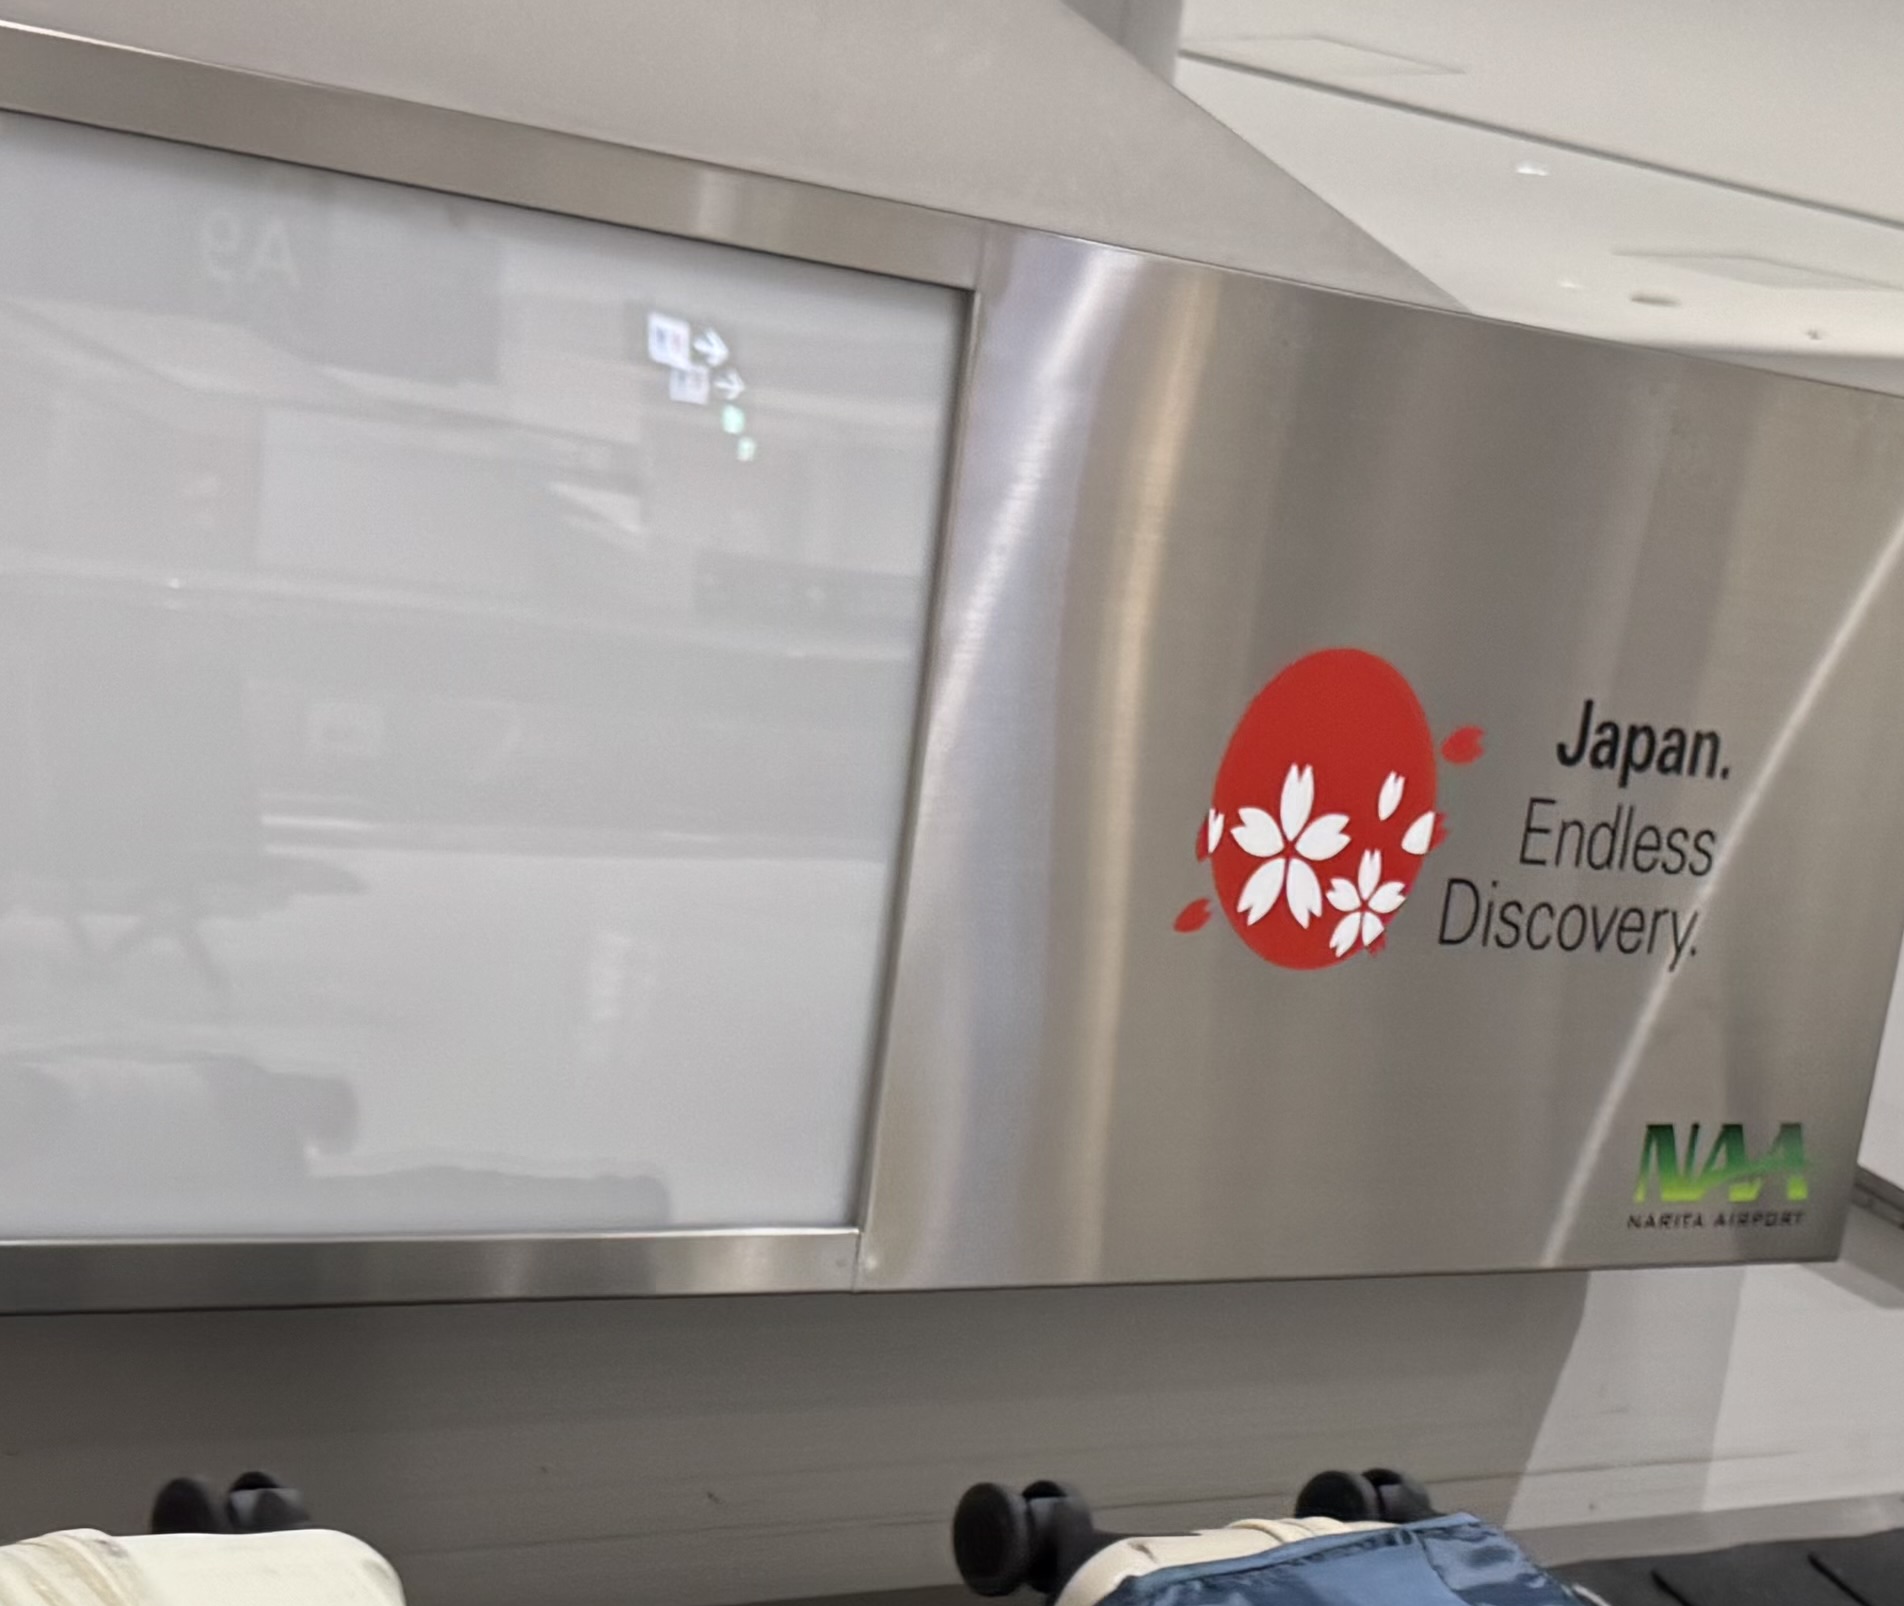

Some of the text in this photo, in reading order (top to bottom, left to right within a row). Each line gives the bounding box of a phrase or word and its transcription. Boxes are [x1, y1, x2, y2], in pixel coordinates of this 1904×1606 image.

[1555, 699, 1731, 788] Japan.
[1519, 797, 1718, 878] Endless
[1438, 878, 1700, 973] Discovery.
[1627, 1210, 1807, 1230] NARITA AIRPORT
